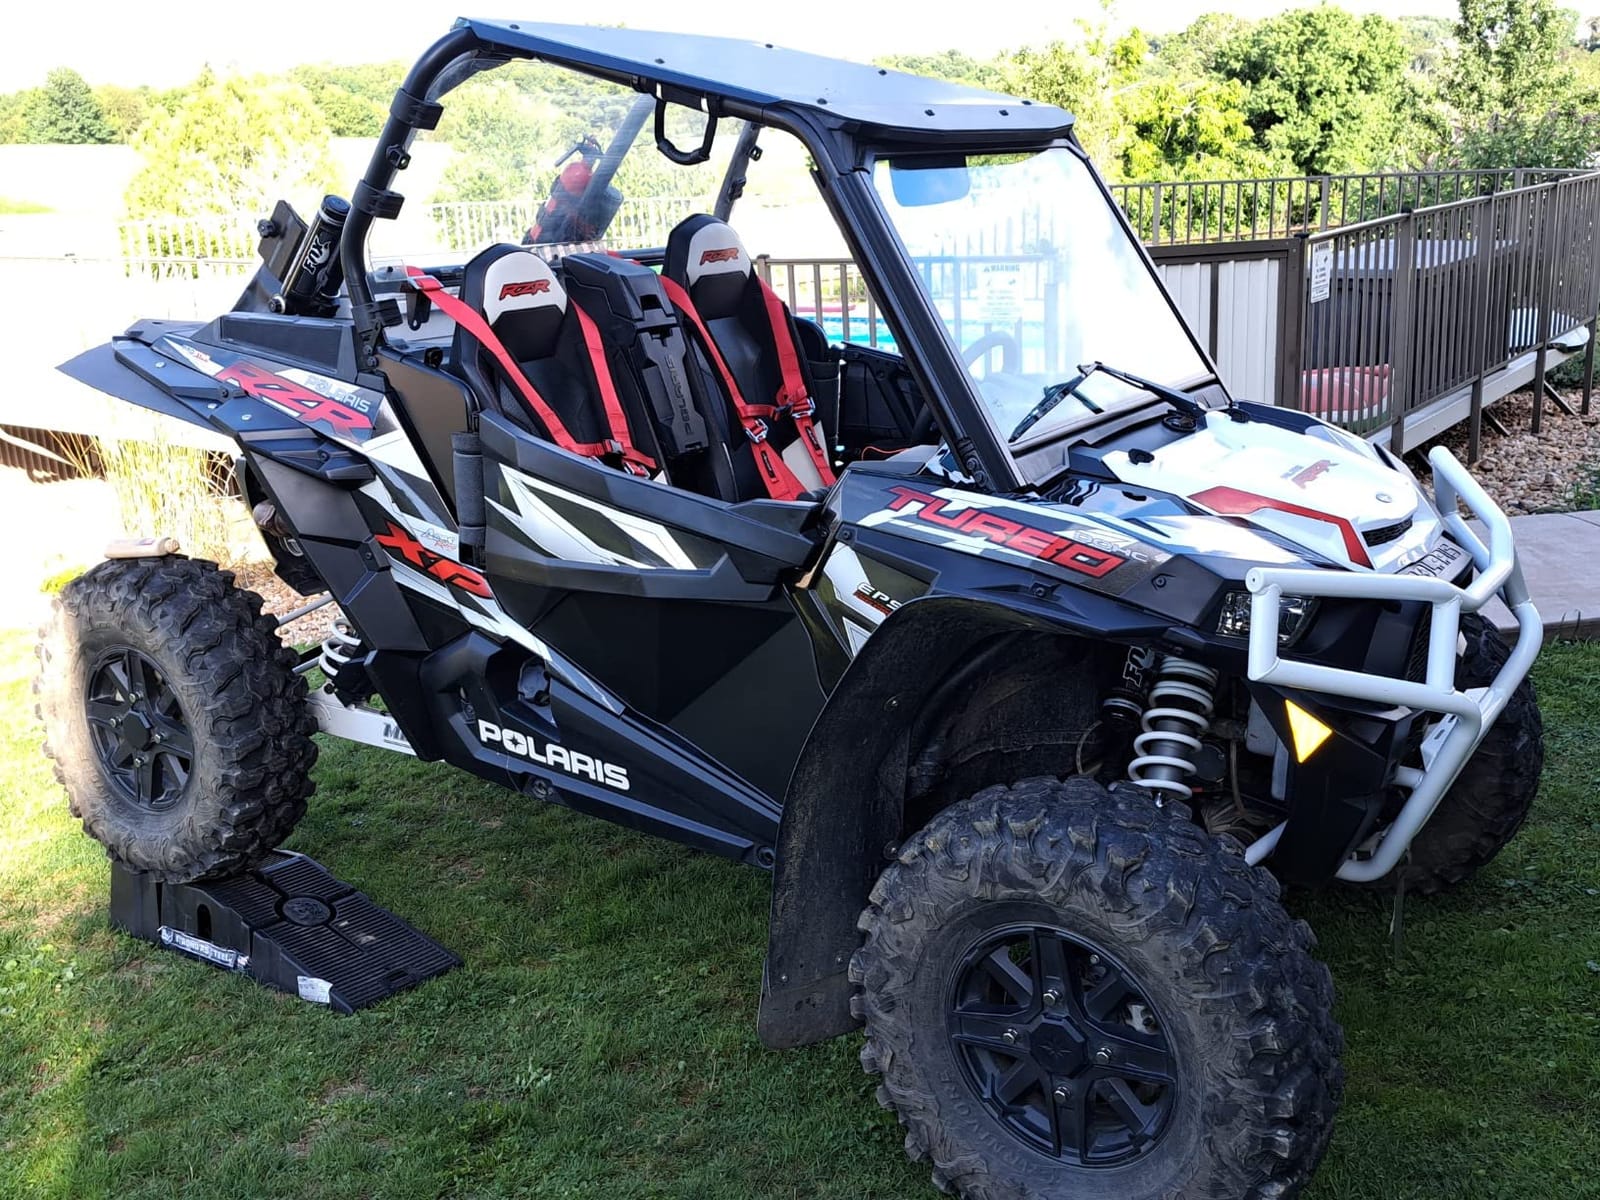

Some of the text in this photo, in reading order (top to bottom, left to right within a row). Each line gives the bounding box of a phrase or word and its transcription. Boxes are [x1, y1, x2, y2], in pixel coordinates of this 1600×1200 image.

[302, 235, 328, 275] FOX
[699, 248, 739, 265] RZR
[499, 279, 550, 301] RZR
[215, 360, 375, 444] RZR
[304, 377, 371, 413] POLARIS
[665, 355, 694, 436] POLARIS
[375, 519, 493, 599] XP
[883, 486, 1128, 578] TURBO
[857, 582, 902, 610] EPS
[478, 719, 630, 790] POLARIS
